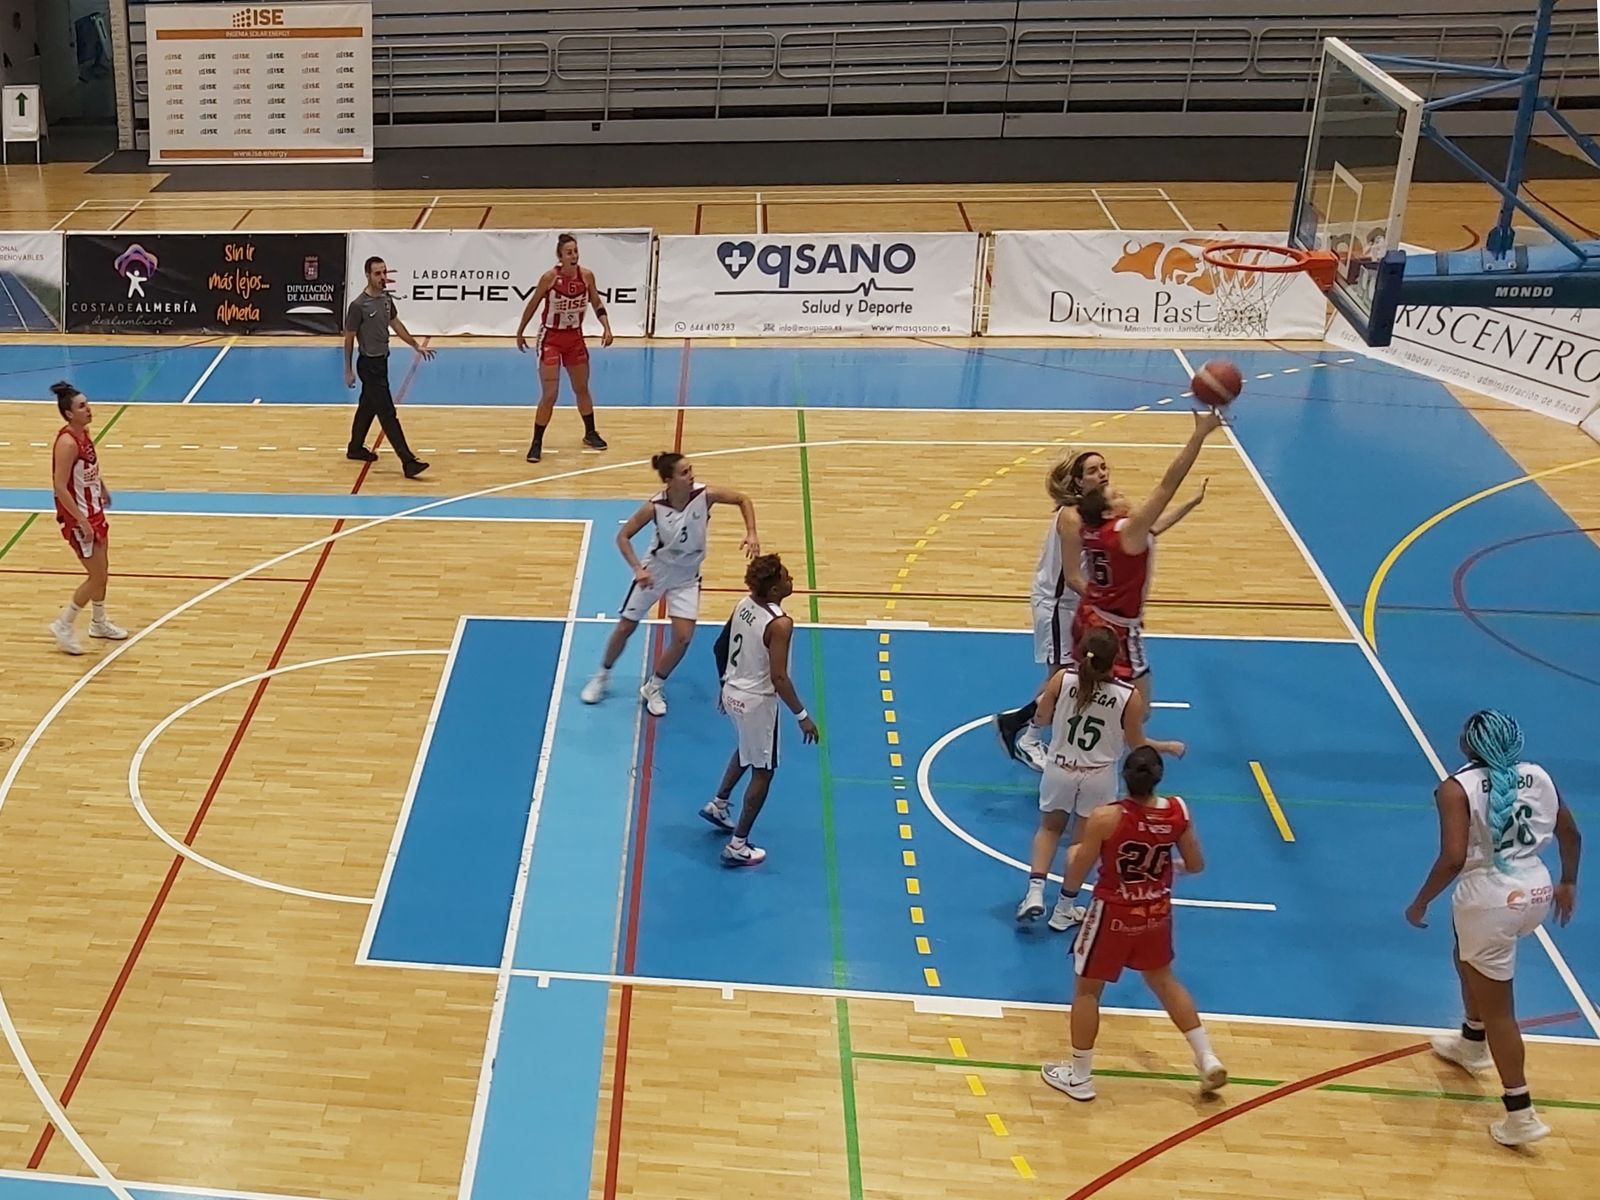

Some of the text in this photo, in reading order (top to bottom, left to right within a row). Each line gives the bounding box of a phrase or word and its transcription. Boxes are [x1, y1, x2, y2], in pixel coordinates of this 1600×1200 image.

[254, 8, 284, 26] ISE
[225, 243, 255, 262] Sin ir
[412, 270, 511, 280] LABORATORIO
[208, 268, 270, 300] más lejos...
[286, 284, 334, 294] DIPUTACIÓN
[1494, 286, 1554, 298] MONDO
[287, 293, 333, 302] DE ALMERÍA
[412, 285, 637, 303] ECHEVNE
[72, 300, 197, 313] COSTADEALMERÍA
[568, 298, 587, 310] ISE
[802, 300, 913, 316] Salud y Deporte
[1050, 290, 1139, 323] Divina
[721, 323, 736, 331] 283
[871, 324, 951, 334] www.masqsano.es
[1176, 324, 1204, 332] Jamón
[740, 607, 757, 627] COLE
[730, 634, 744, 668] 2
[1070, 686, 1118, 709] OEGA
[1067, 715, 1106, 752] 15
